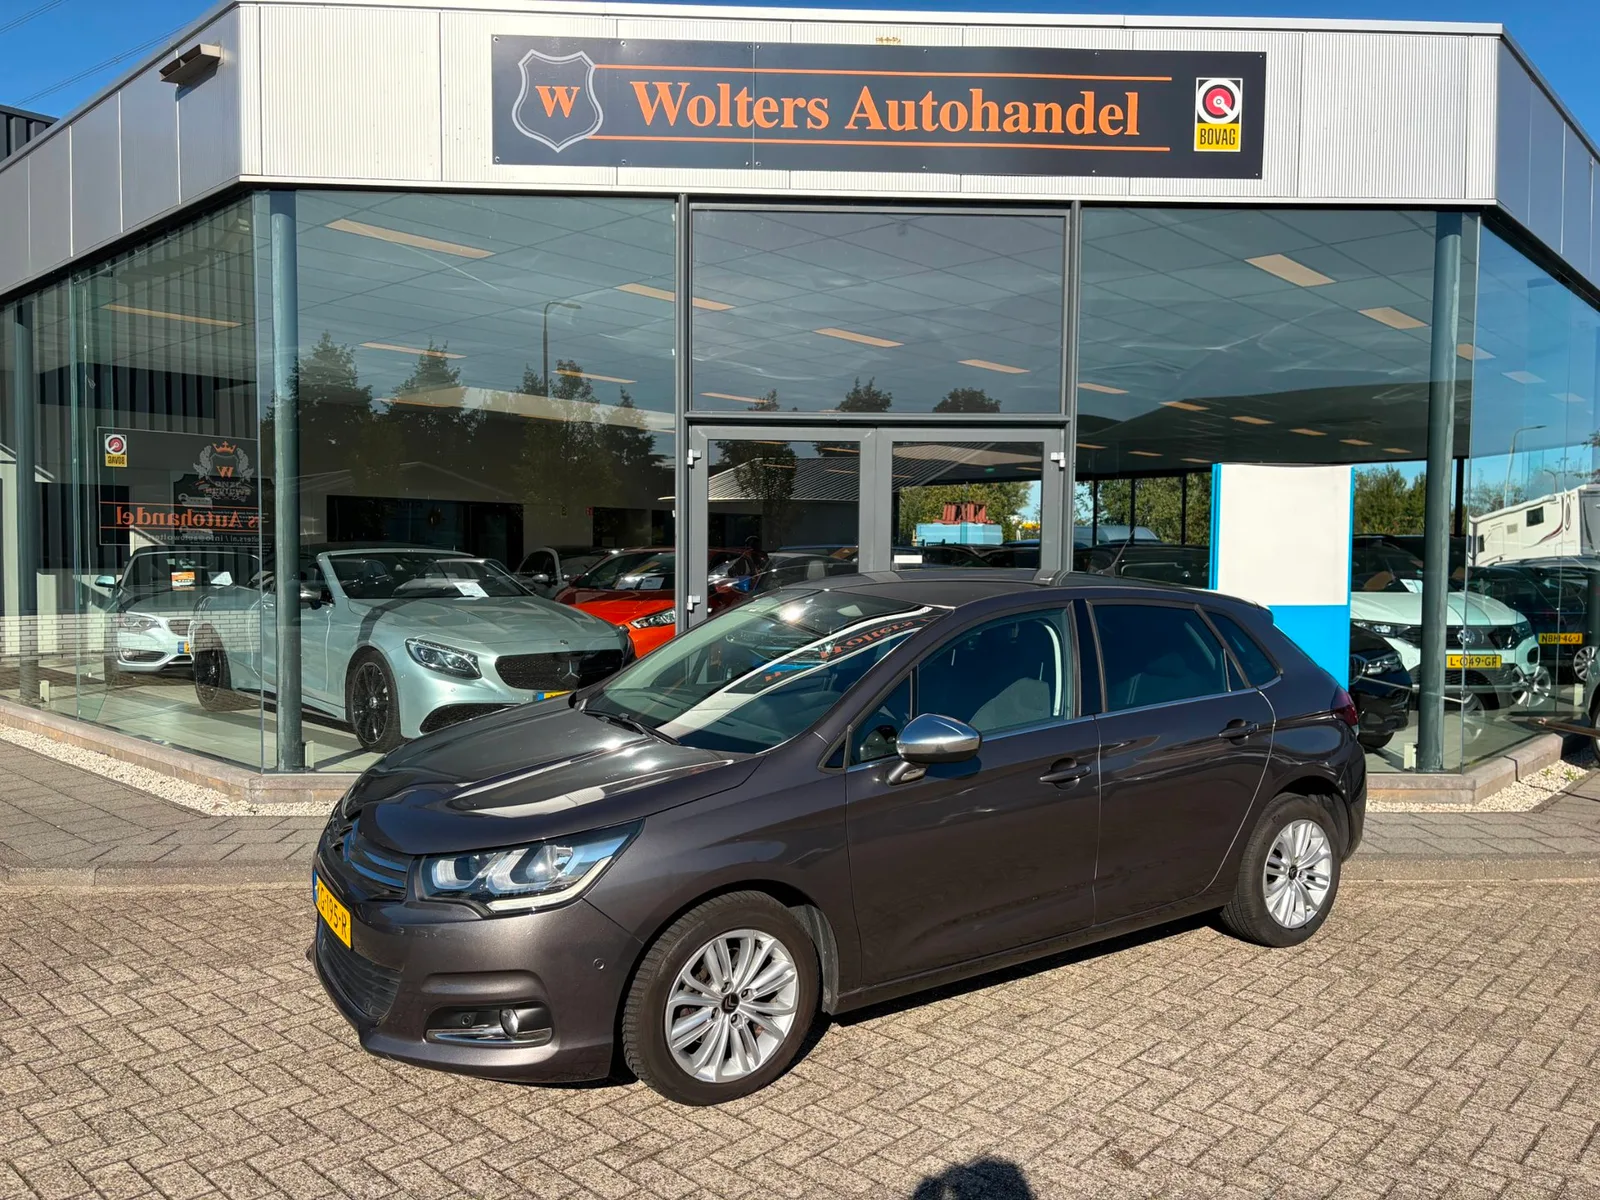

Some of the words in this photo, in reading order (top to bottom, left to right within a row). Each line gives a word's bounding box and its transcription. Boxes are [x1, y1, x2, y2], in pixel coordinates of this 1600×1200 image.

[535, 85, 581, 119] W
[629, 80, 830, 130] Wolters
[844, 85, 1140, 137] Autohandel
[1200, 126, 1237, 146] BOVAG
